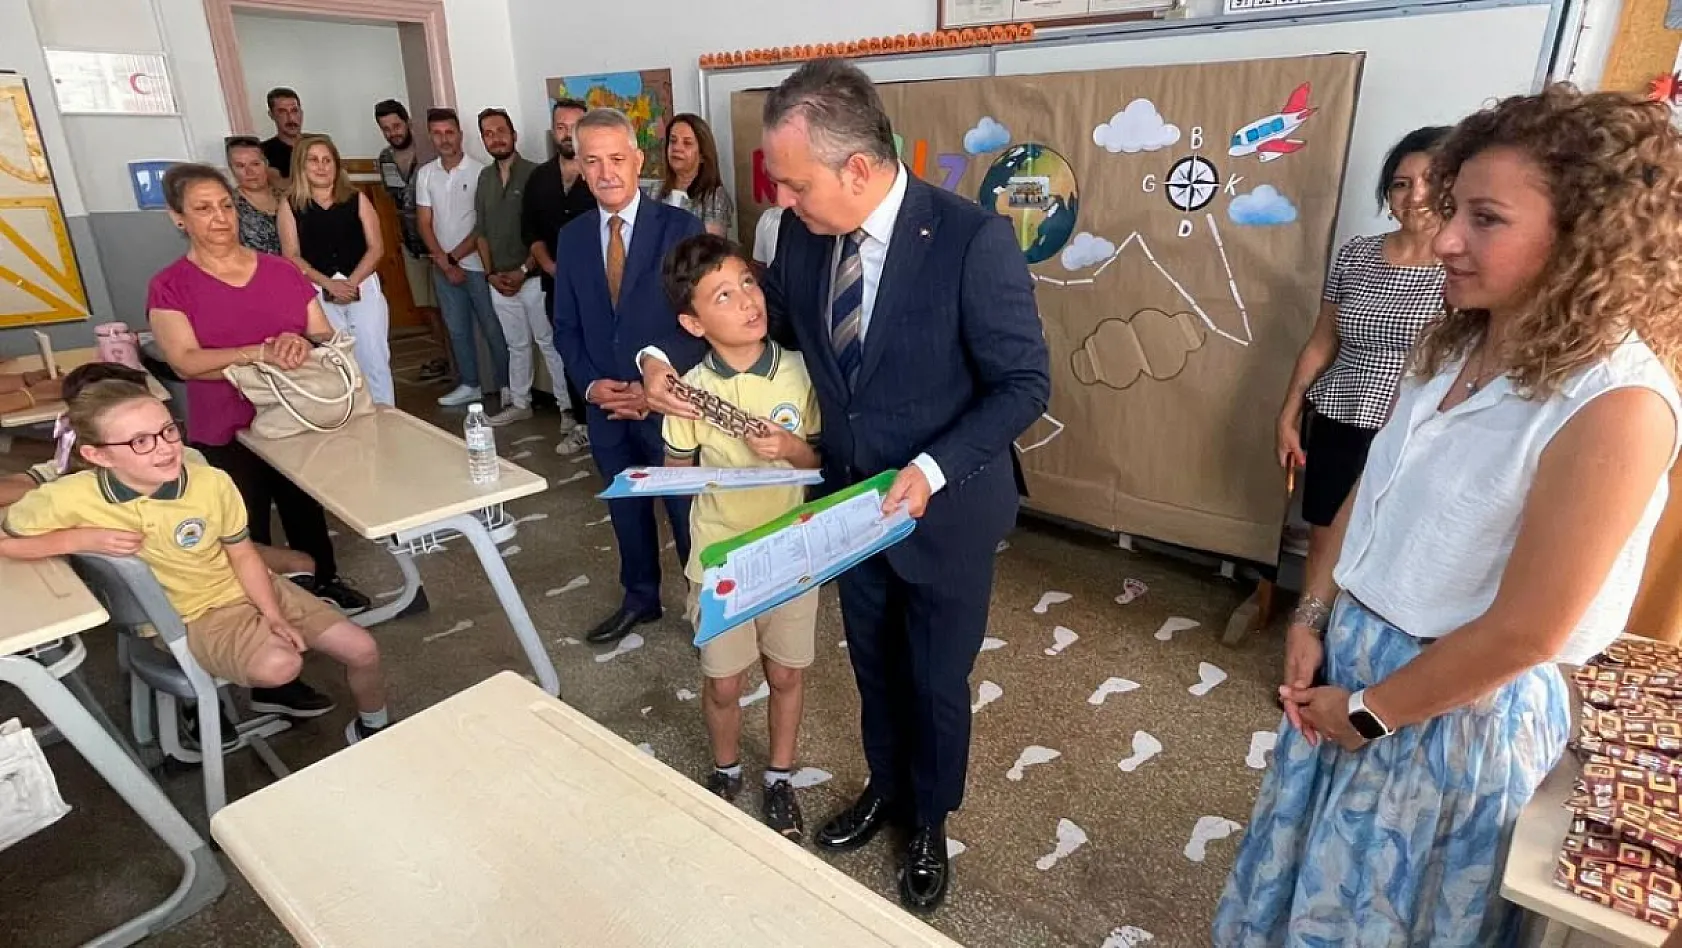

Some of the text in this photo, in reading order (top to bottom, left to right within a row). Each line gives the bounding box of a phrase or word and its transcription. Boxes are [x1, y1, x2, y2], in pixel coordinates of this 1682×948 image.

[1190, 126, 1203, 149] B
[1142, 174, 1156, 192] G
[1224, 173, 1245, 196] K
[1178, 219, 1193, 237] D
